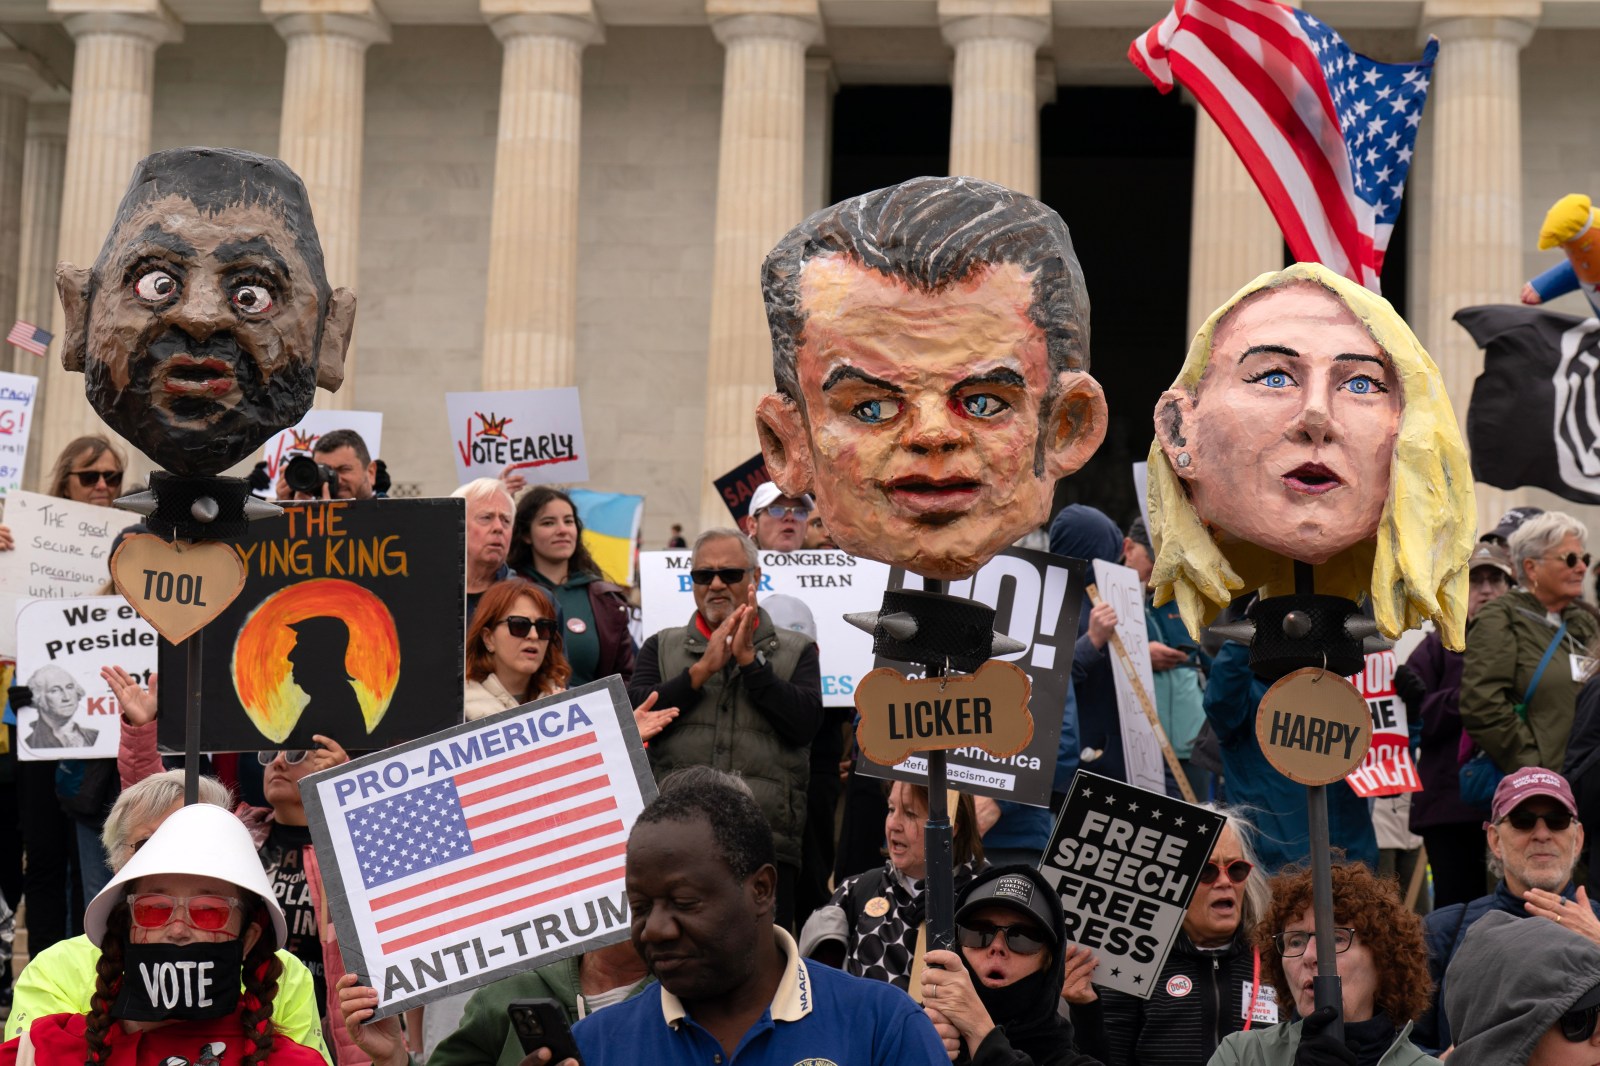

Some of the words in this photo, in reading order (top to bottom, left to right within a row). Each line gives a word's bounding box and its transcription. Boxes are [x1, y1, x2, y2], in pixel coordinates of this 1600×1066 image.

[510, 433, 573, 461] EARLY
[283, 502, 348, 538] THE
[235, 538, 313, 576] YING
[325, 535, 410, 577] KING
[666, 557, 692, 569] MA
[763, 553, 857, 567] CONGRESS
[143, 569, 206, 607] TOOL
[797, 574, 852, 588] THAN
[62, 605, 107, 627] We
[903, 554, 1069, 669] O!
[46, 627, 158, 660] Preside
[821, 675, 854, 695] ES
[888, 697, 993, 740] LICKER
[1269, 710, 1361, 760] HARPY
[333, 703, 594, 807] PRO-AMERICA
[903, 759, 1007, 788] Refuascism.org
[1078, 809, 1189, 868] FREE
[1004, 883, 1024, 891] DELTA
[1053, 837, 1189, 903] SPEECH
[272, 882, 314, 906] PLA
[1002, 887, 1024, 896] TANGO
[1055, 875, 1161, 931] FREE
[383, 890, 631, 1002] ANTI-TRUM
[1063, 909, 1160, 964] RESS
[139, 961, 214, 1009] VOTE
